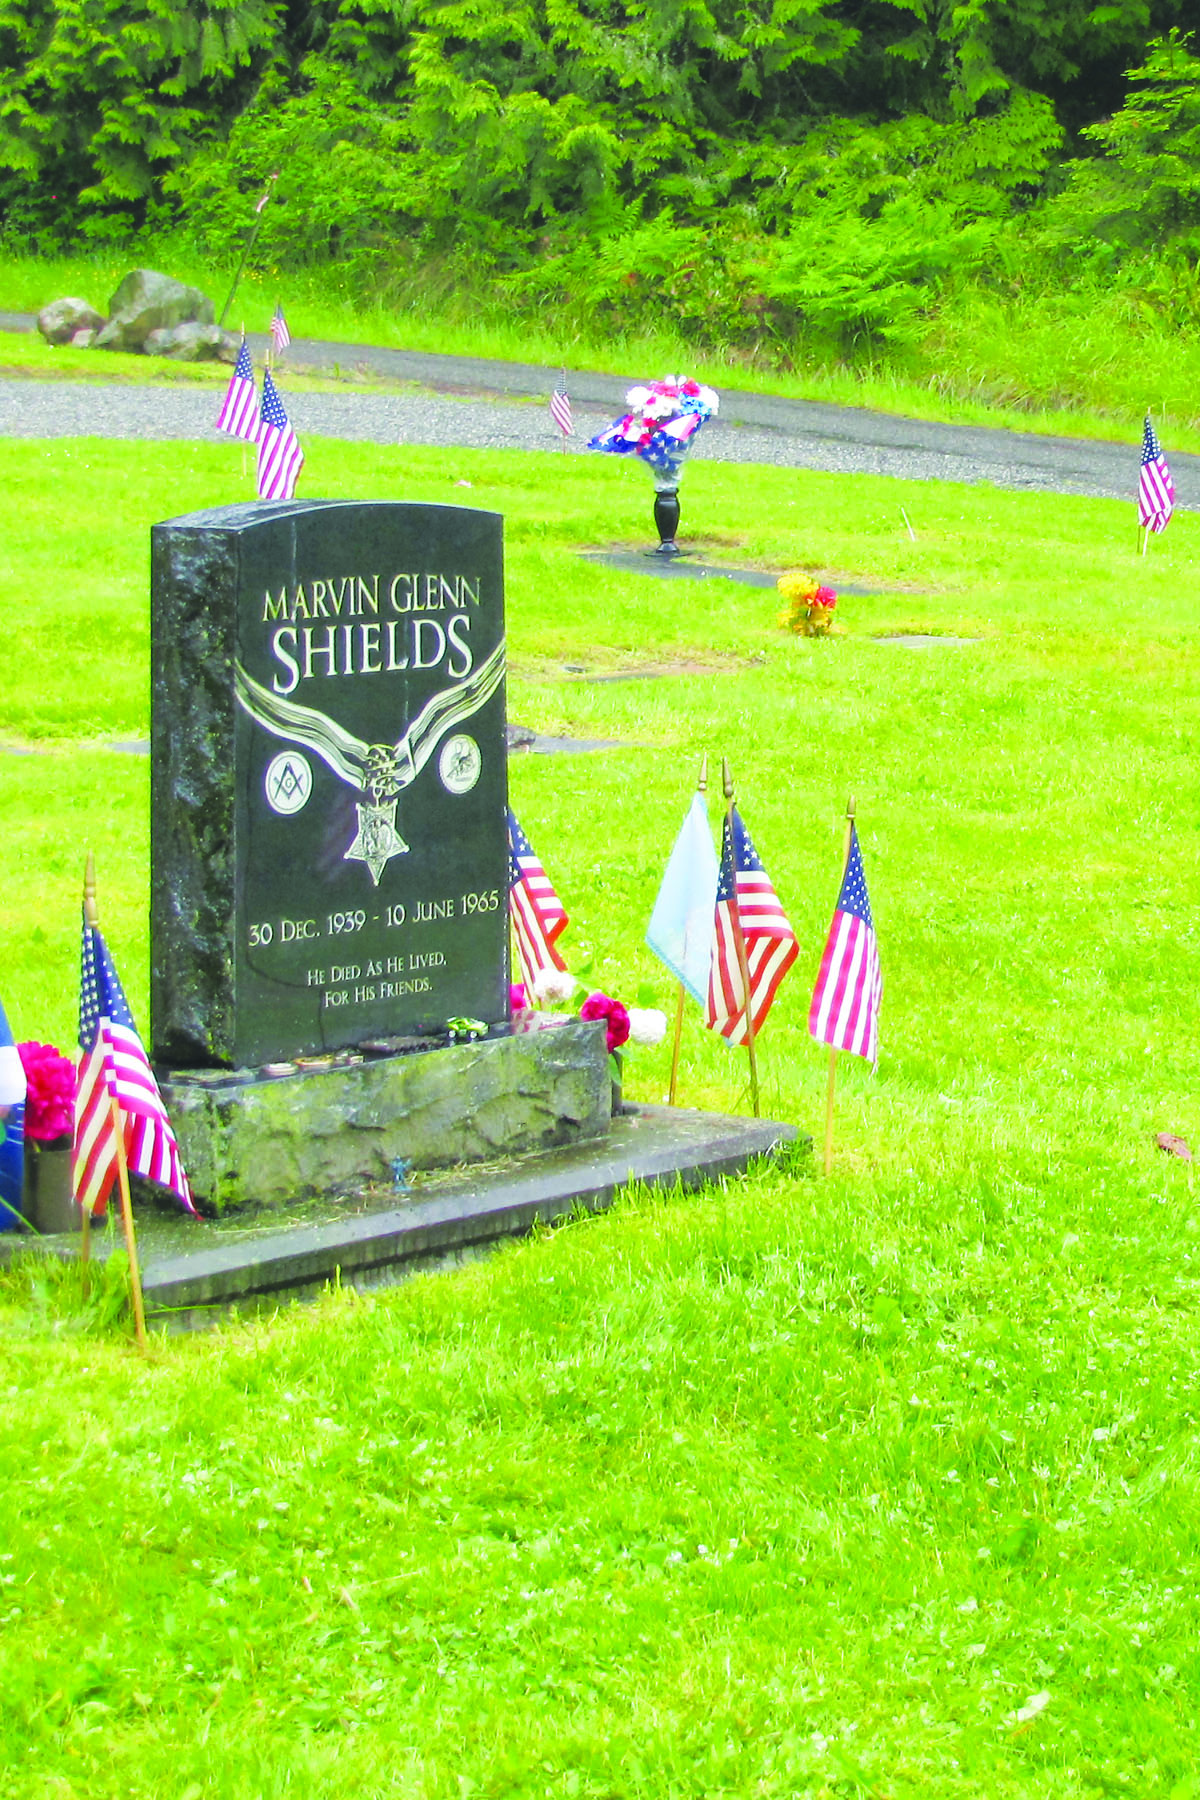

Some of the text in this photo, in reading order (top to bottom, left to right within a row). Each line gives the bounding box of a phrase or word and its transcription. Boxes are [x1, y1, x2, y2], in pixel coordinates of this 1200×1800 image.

[262, 572, 482, 622] MARVIN GLENN
[273, 614, 473, 694] SHIELDS
[248, 922, 273, 946] 30
[280, 919, 320, 943] DEC.
[327, 909, 366, 935] 1939
[386, 903, 405, 927] 10
[412, 899, 454, 923] JUNE
[461, 890, 499, 915] 1965
[307, 969, 325, 986] HE
[331, 965, 361, 982] DIED
[366, 960, 383, 977] AS
[387, 957, 404, 974] HE
[324, 977, 433, 1008] FOR HIS FRIENDS.
